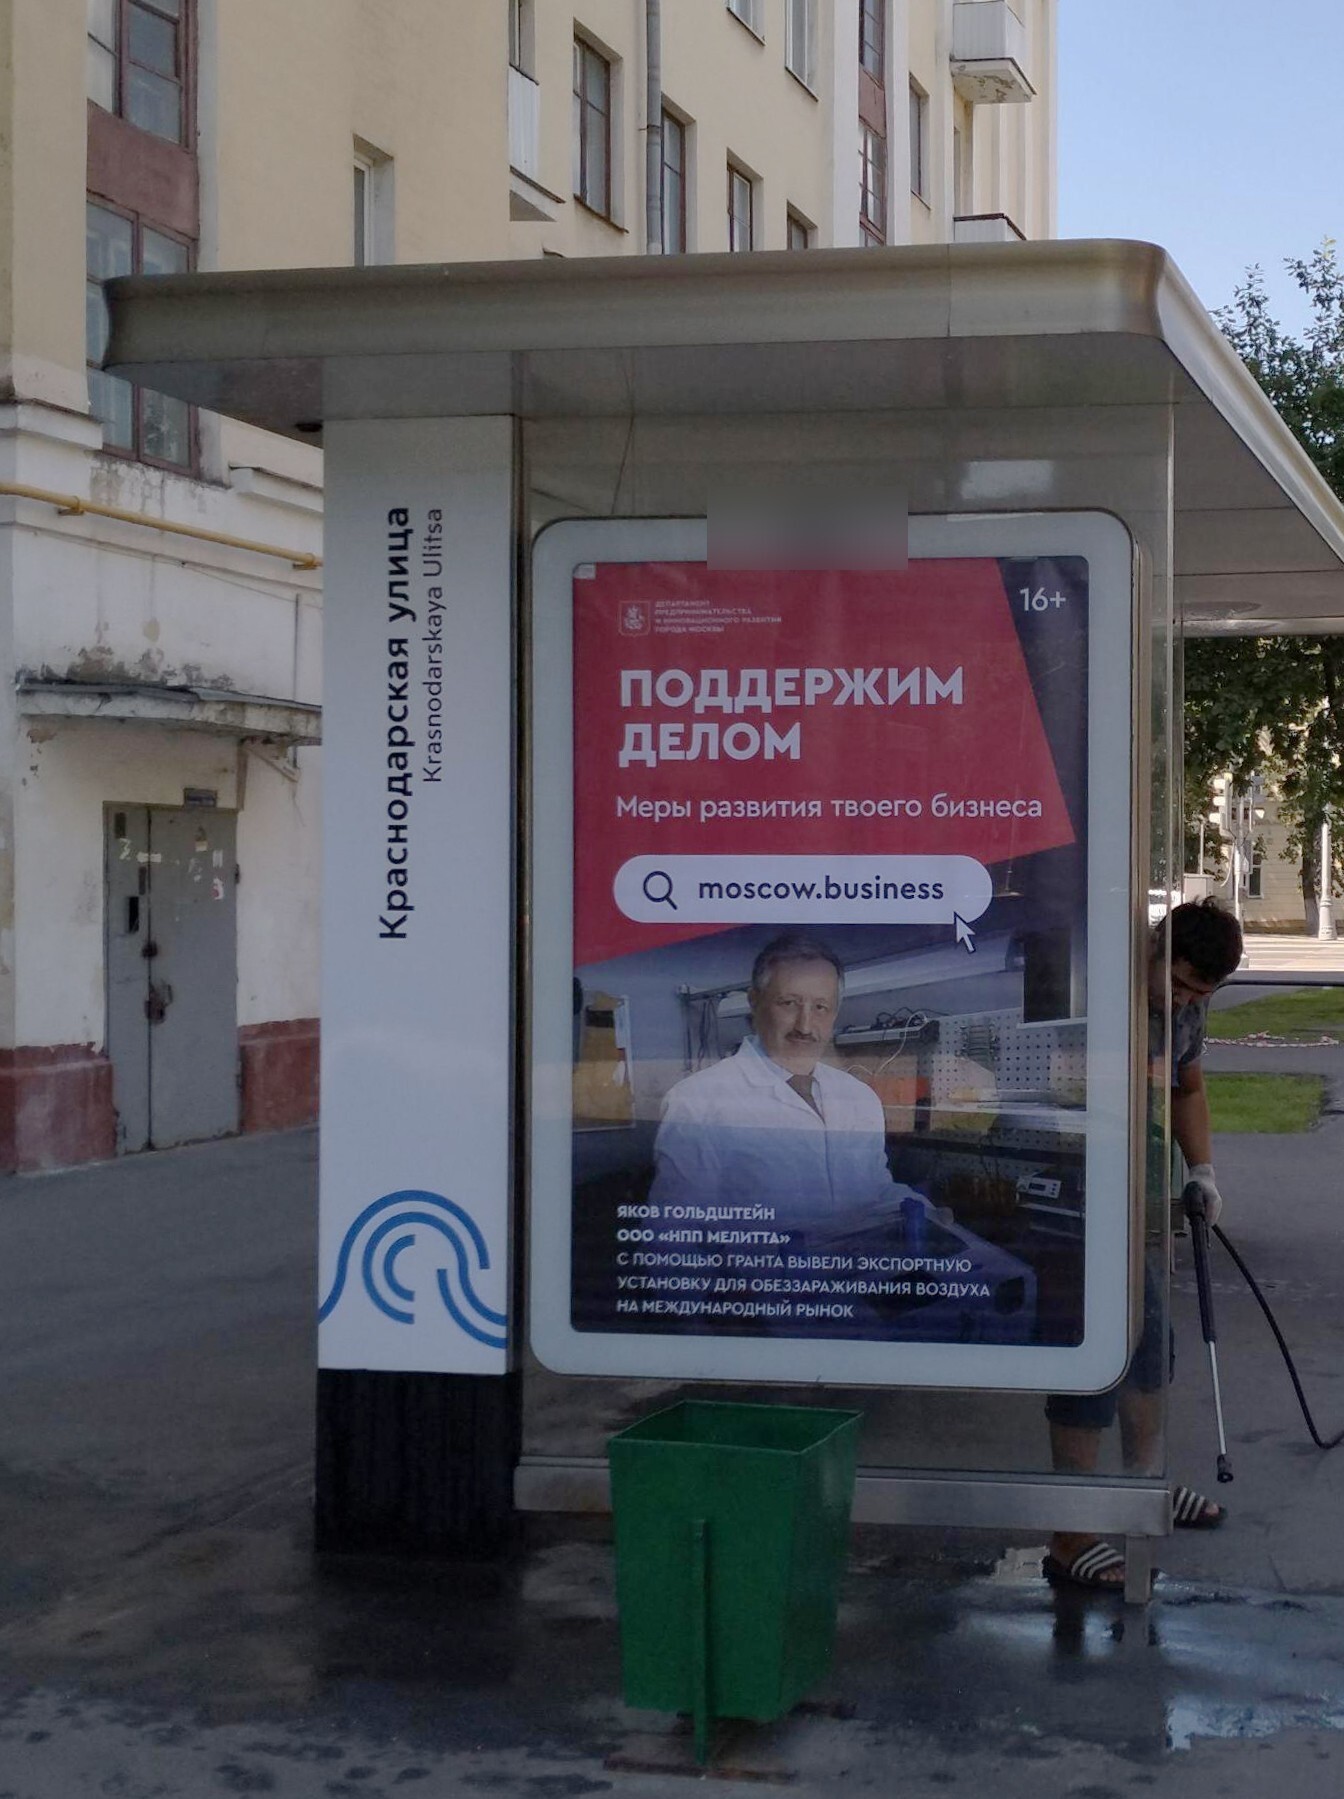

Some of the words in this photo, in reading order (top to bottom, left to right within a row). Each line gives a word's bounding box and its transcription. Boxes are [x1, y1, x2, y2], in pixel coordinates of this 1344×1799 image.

[422, 507, 443, 577] Ulitsa
[387, 506, 417, 622] улица
[1019, 587, 1067, 612] 16+
[422, 586, 448, 783] Krasnodarskaya
[620, 666, 964, 714] ПОДДЕРЖИМ
[618, 722, 801, 768] ДЕЛОМ
[380, 637, 416, 939] Краснодарская
[616, 796, 691, 823] Меры
[700, 798, 822, 823] развития
[831, 798, 922, 818] твоего
[931, 793, 1043, 818] бизнеса
[698, 875, 944, 901] moscow.business
[617, 1205, 661, 1219] ЯКОВ
[663, 1204, 776, 1222] ГОЛЬДШТЕЙН
[616, 1229, 655, 1242] ООО
[658, 1229, 703, 1244] «НПП
[706, 1230, 791, 1245] МЕЛИТТА»
[616, 1252, 629, 1267] С
[632, 1252, 724, 1270] ПОМОЩЬЮ
[726, 1254, 785, 1268] ГРАНТА
[787, 1256, 853, 1270] ВЫВЕЛИ
[857, 1256, 973, 1273] ЭКСПОРТНУЮ
[617, 1275, 712, 1291] УСТАНОВКУ
[714, 1277, 748, 1292] ДЛЯ
[750, 1278, 912, 1295] ОБЕЗЗАРАЖИВАНИЯ
[915, 1282, 991, 1298] ВОЗДУХА
[616, 1300, 639, 1314] НА
[642, 1300, 793, 1319] МЕЖДУНАРОДНЫЙ
[796, 1303, 855, 1318] РЫНОК
